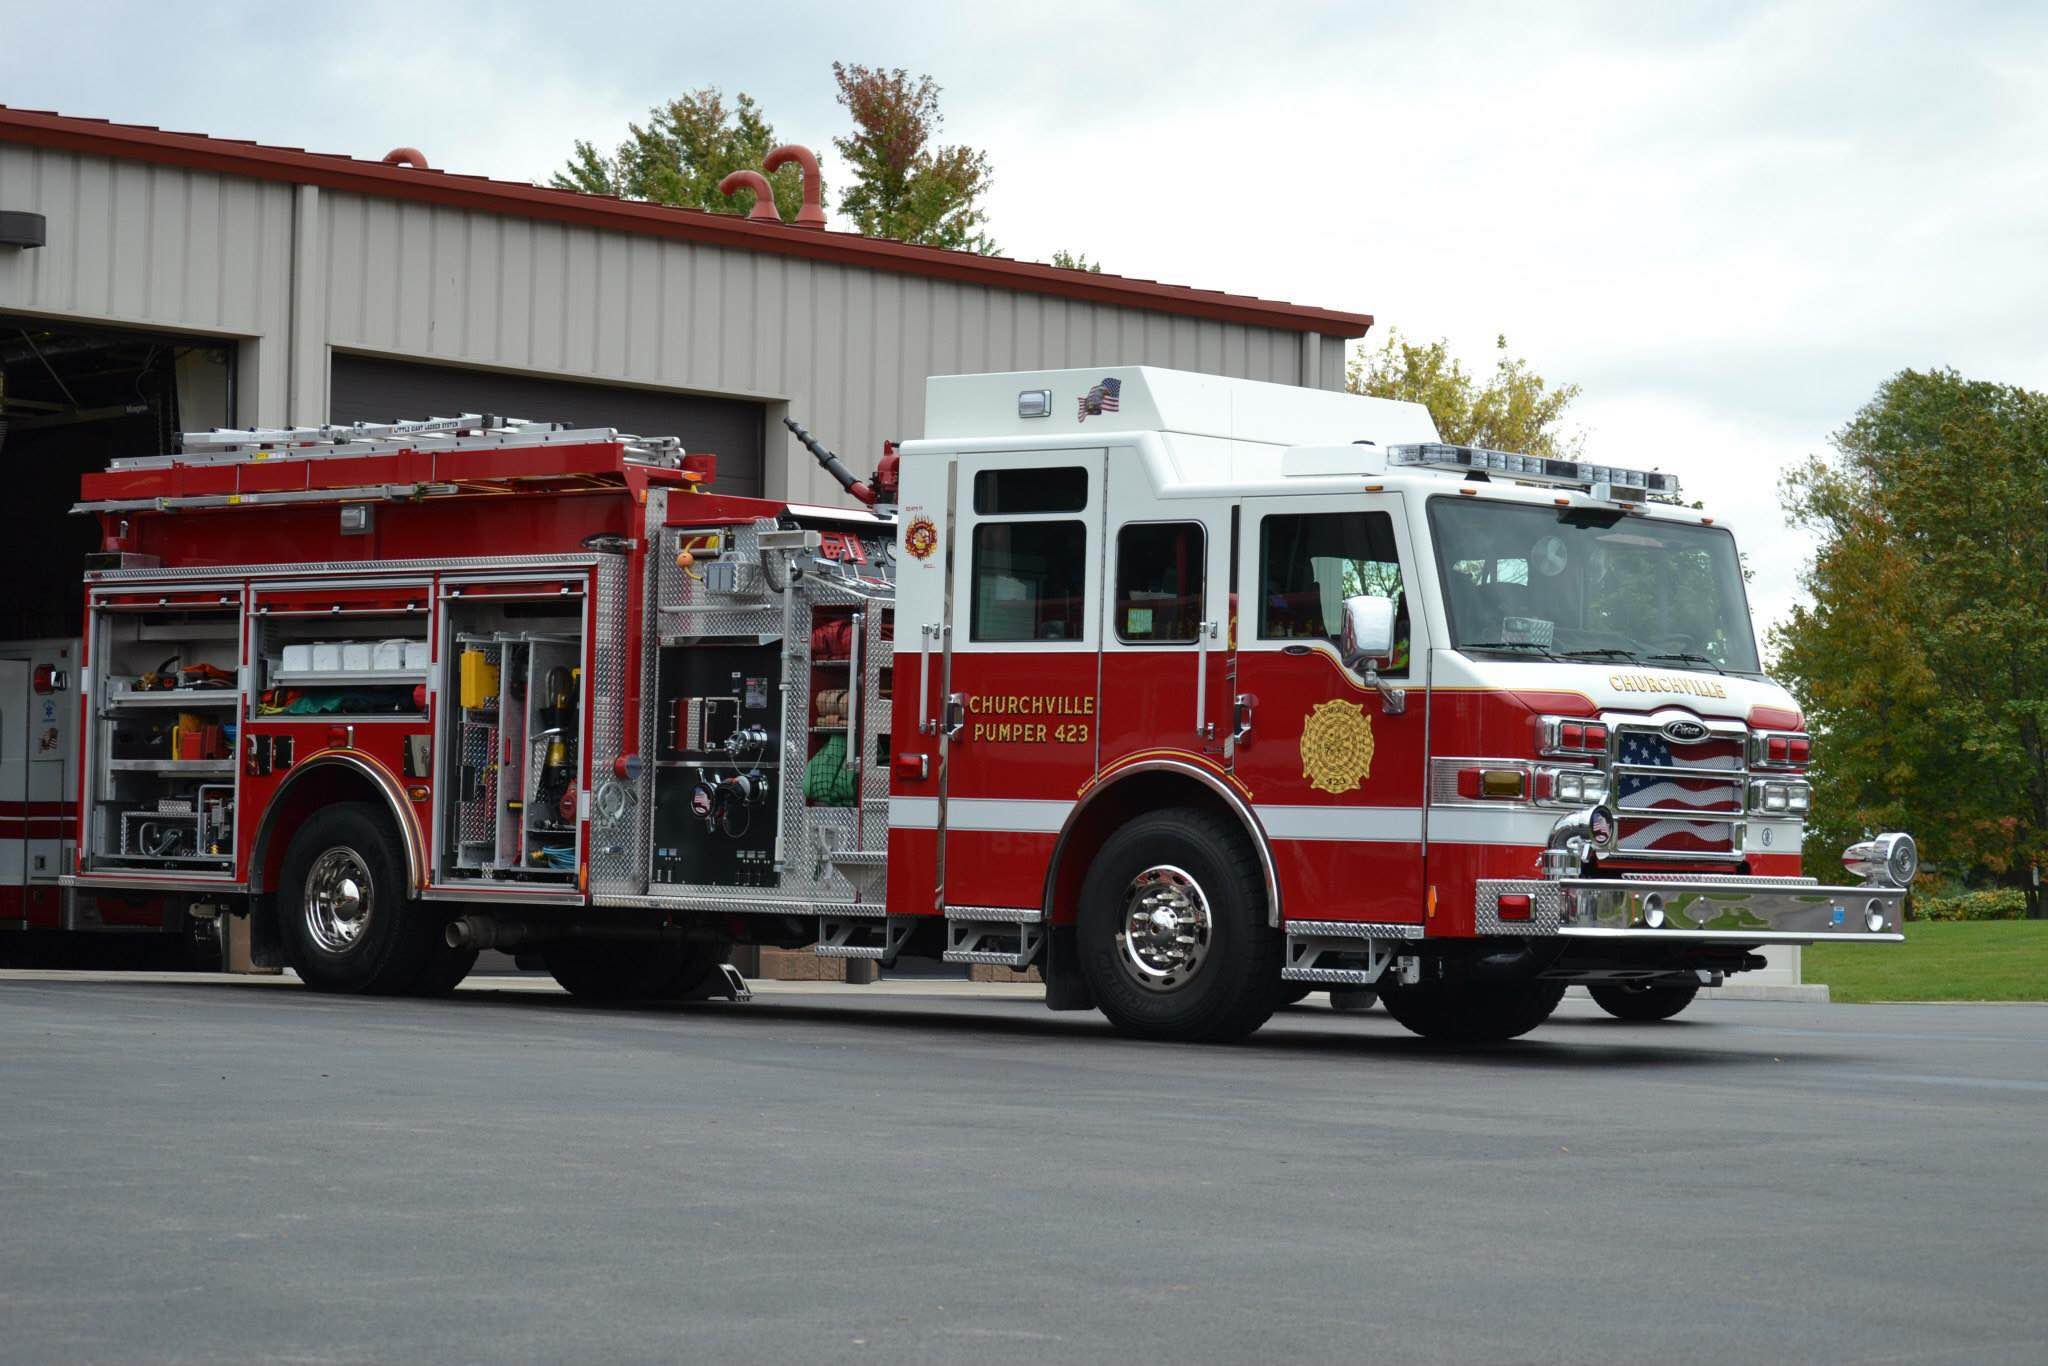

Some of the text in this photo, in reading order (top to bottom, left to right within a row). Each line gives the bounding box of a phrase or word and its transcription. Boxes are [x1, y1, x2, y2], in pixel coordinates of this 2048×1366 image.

[1609, 673, 1727, 698] CHURCHVILLE
[969, 695, 1094, 714] CHURCHVILLE
[974, 723, 1089, 742] PUMPER 423
